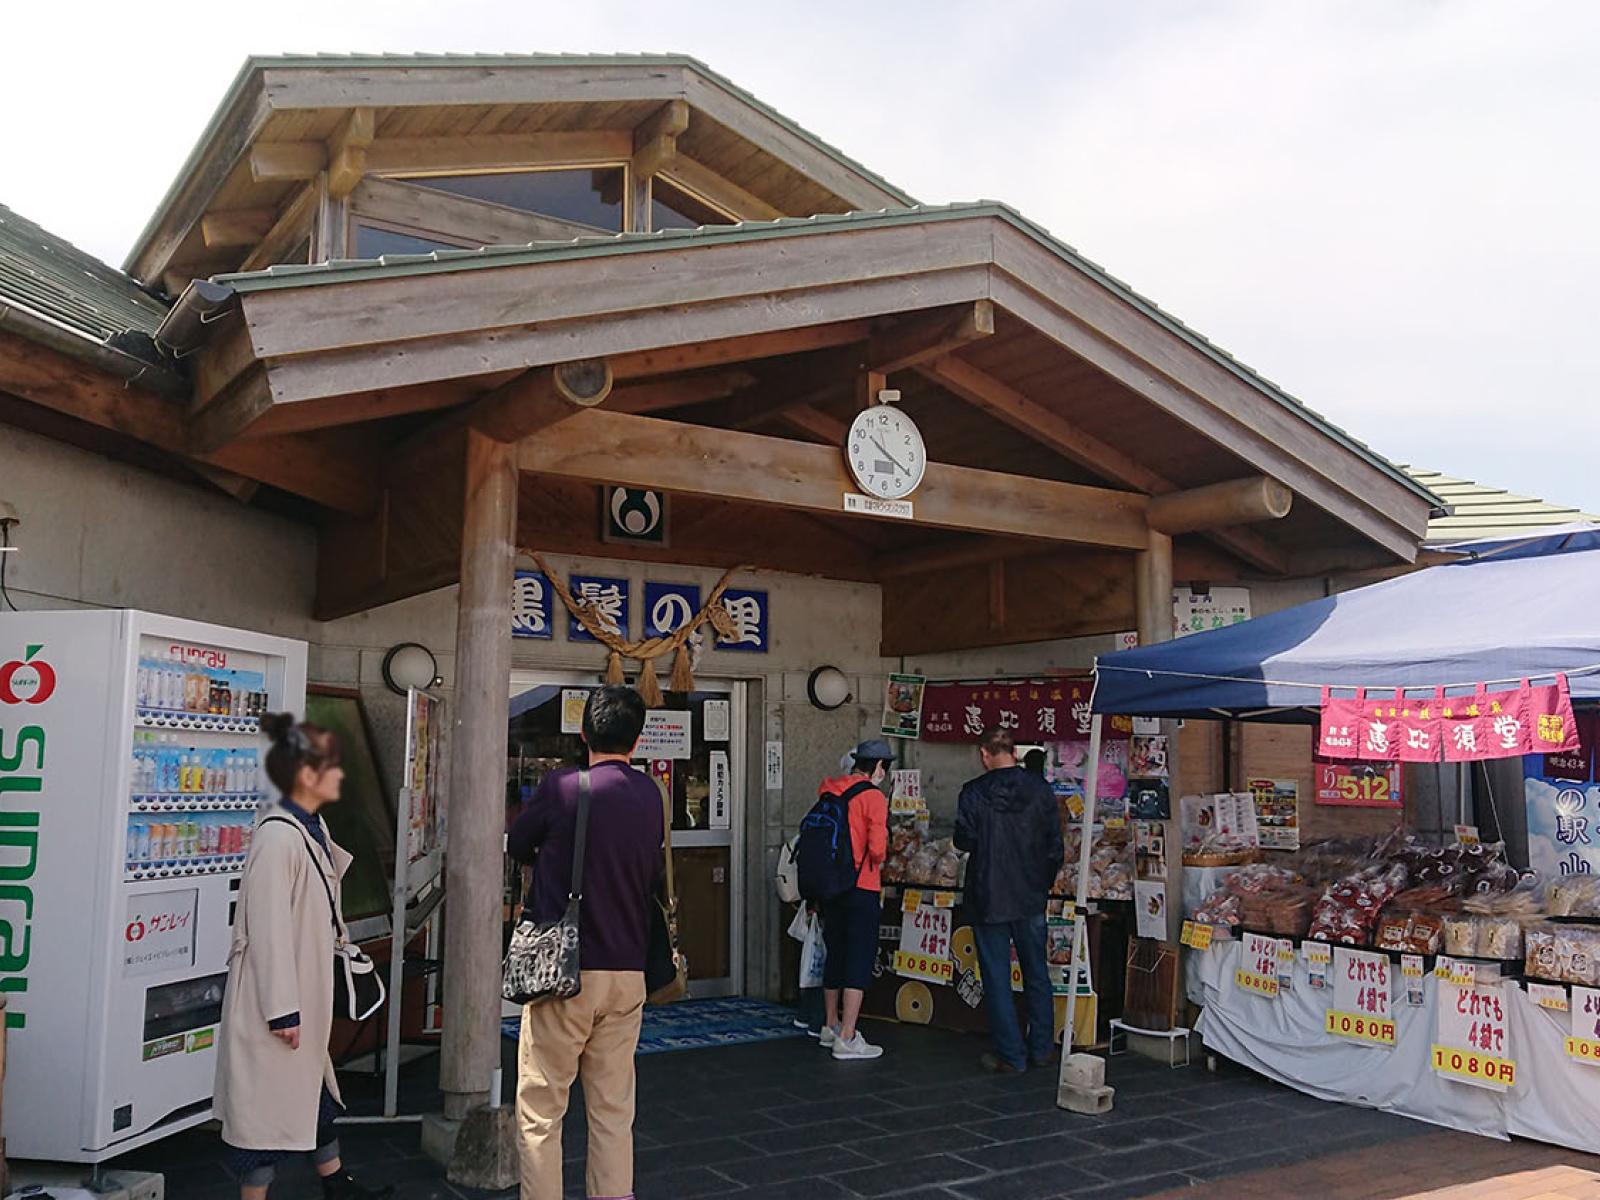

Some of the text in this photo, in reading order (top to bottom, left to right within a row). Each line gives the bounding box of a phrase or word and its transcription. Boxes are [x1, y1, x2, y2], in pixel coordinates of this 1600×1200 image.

[896, 954, 953, 978] 1080円
[1347, 956, 1387, 986] どれでも
[1237, 972, 1278, 994] 1080円
[1456, 988, 1503, 1022] どれでも
[1329, 1014, 1395, 1041] 1080円
[1436, 1050, 1514, 1083] 1080円
